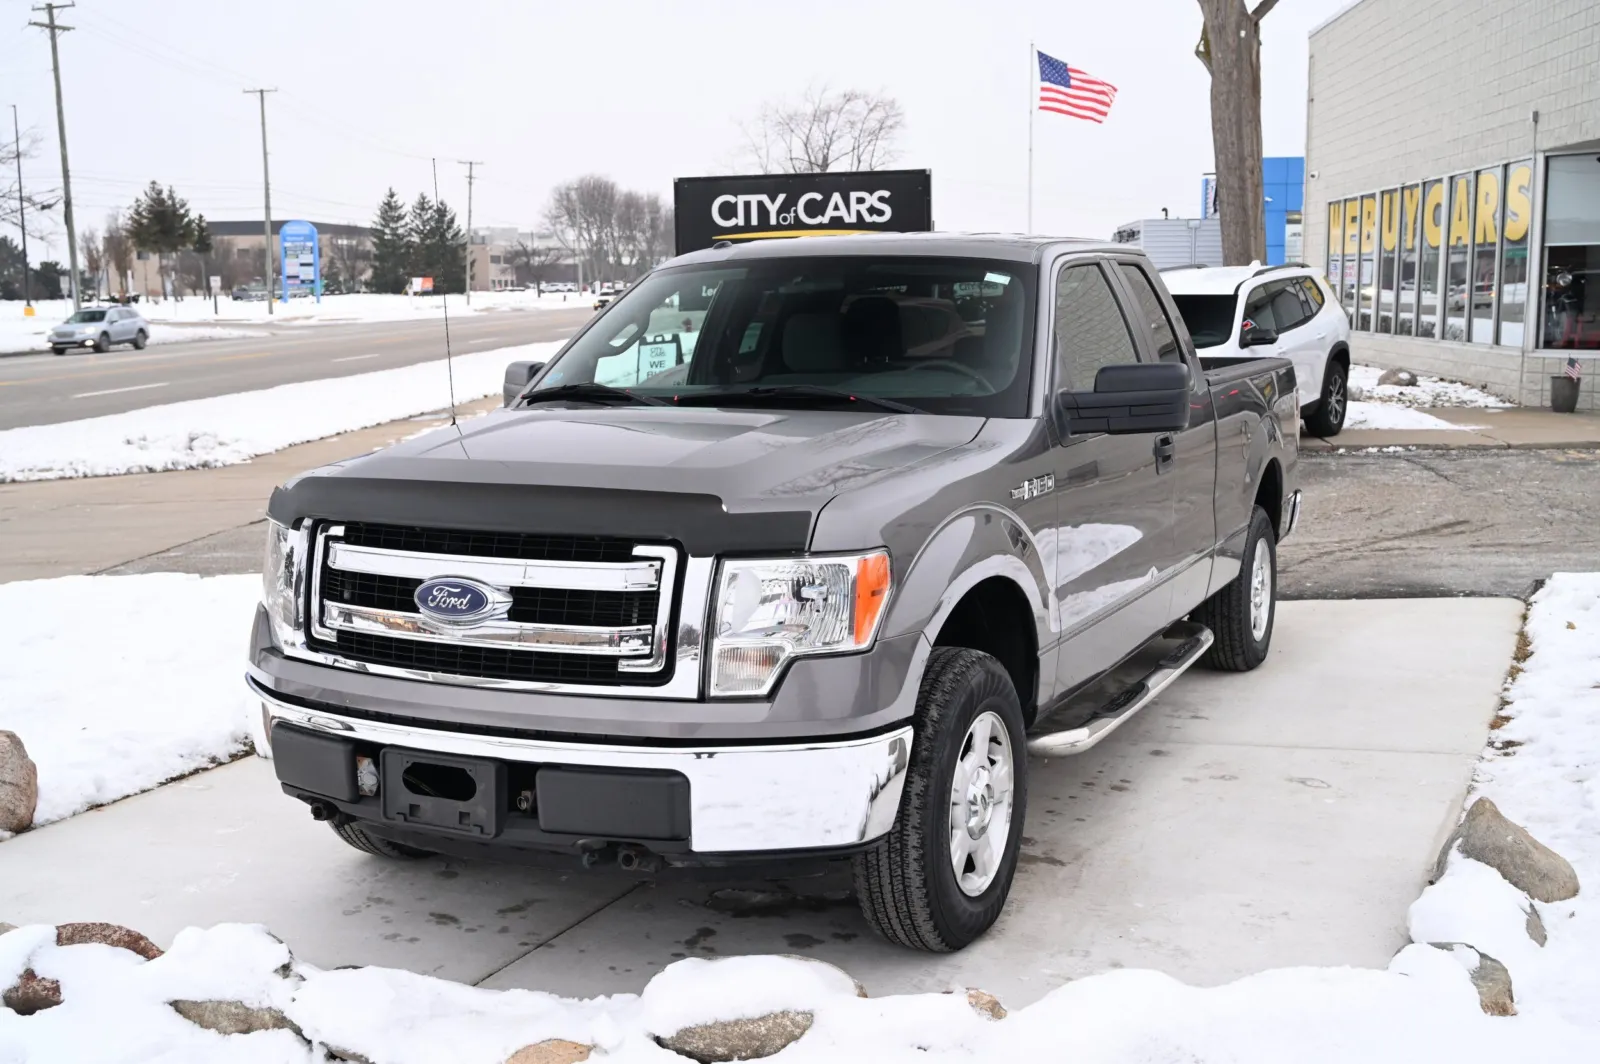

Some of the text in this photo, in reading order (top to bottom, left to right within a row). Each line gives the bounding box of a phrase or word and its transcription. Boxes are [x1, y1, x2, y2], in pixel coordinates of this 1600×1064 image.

[711, 190, 892, 228] CITY of CARS
[1329, 166, 1532, 254] WE BUY CARS
[650, 360, 665, 368] WE
[428, 585, 471, 609] Ford
